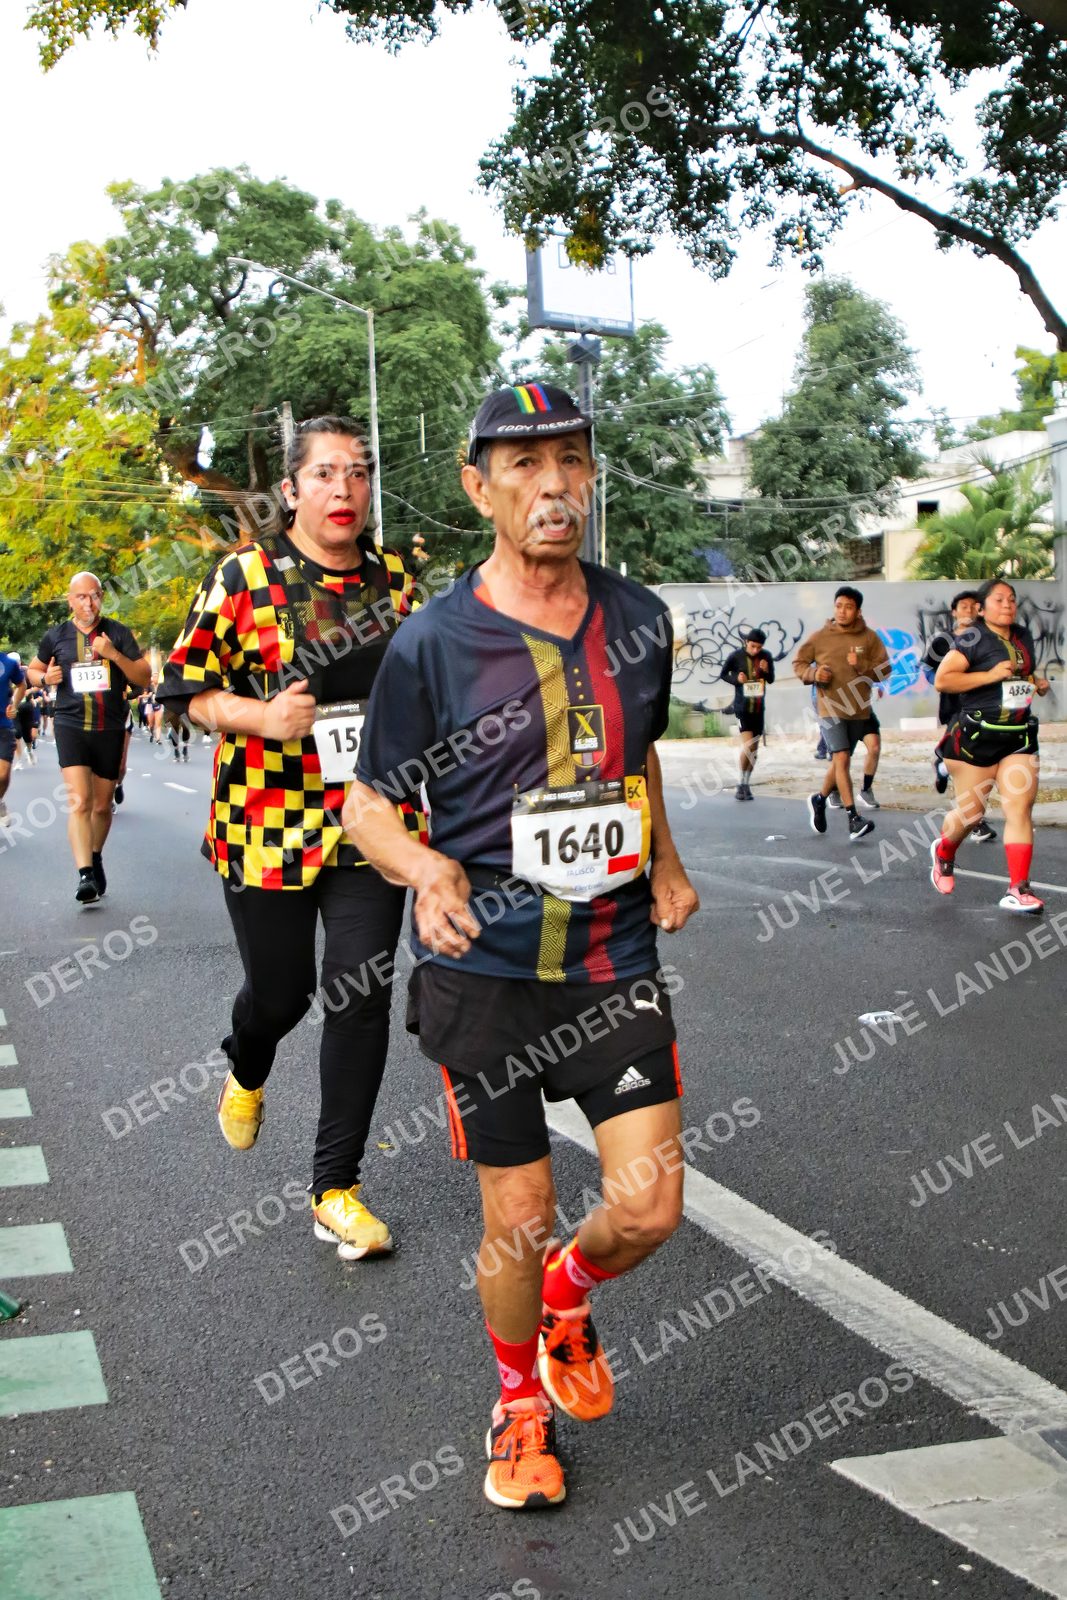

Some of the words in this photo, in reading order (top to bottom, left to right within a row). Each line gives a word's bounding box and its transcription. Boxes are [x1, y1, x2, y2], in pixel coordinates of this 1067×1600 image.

[77, 670, 103, 681] 3135
[1009, 684, 1032, 696] 4356
[328, 726, 363, 753] 15
[627, 785, 642, 799] 5K
[534, 819, 624, 866] 1640
[614, 1078, 652, 1095] adidas
